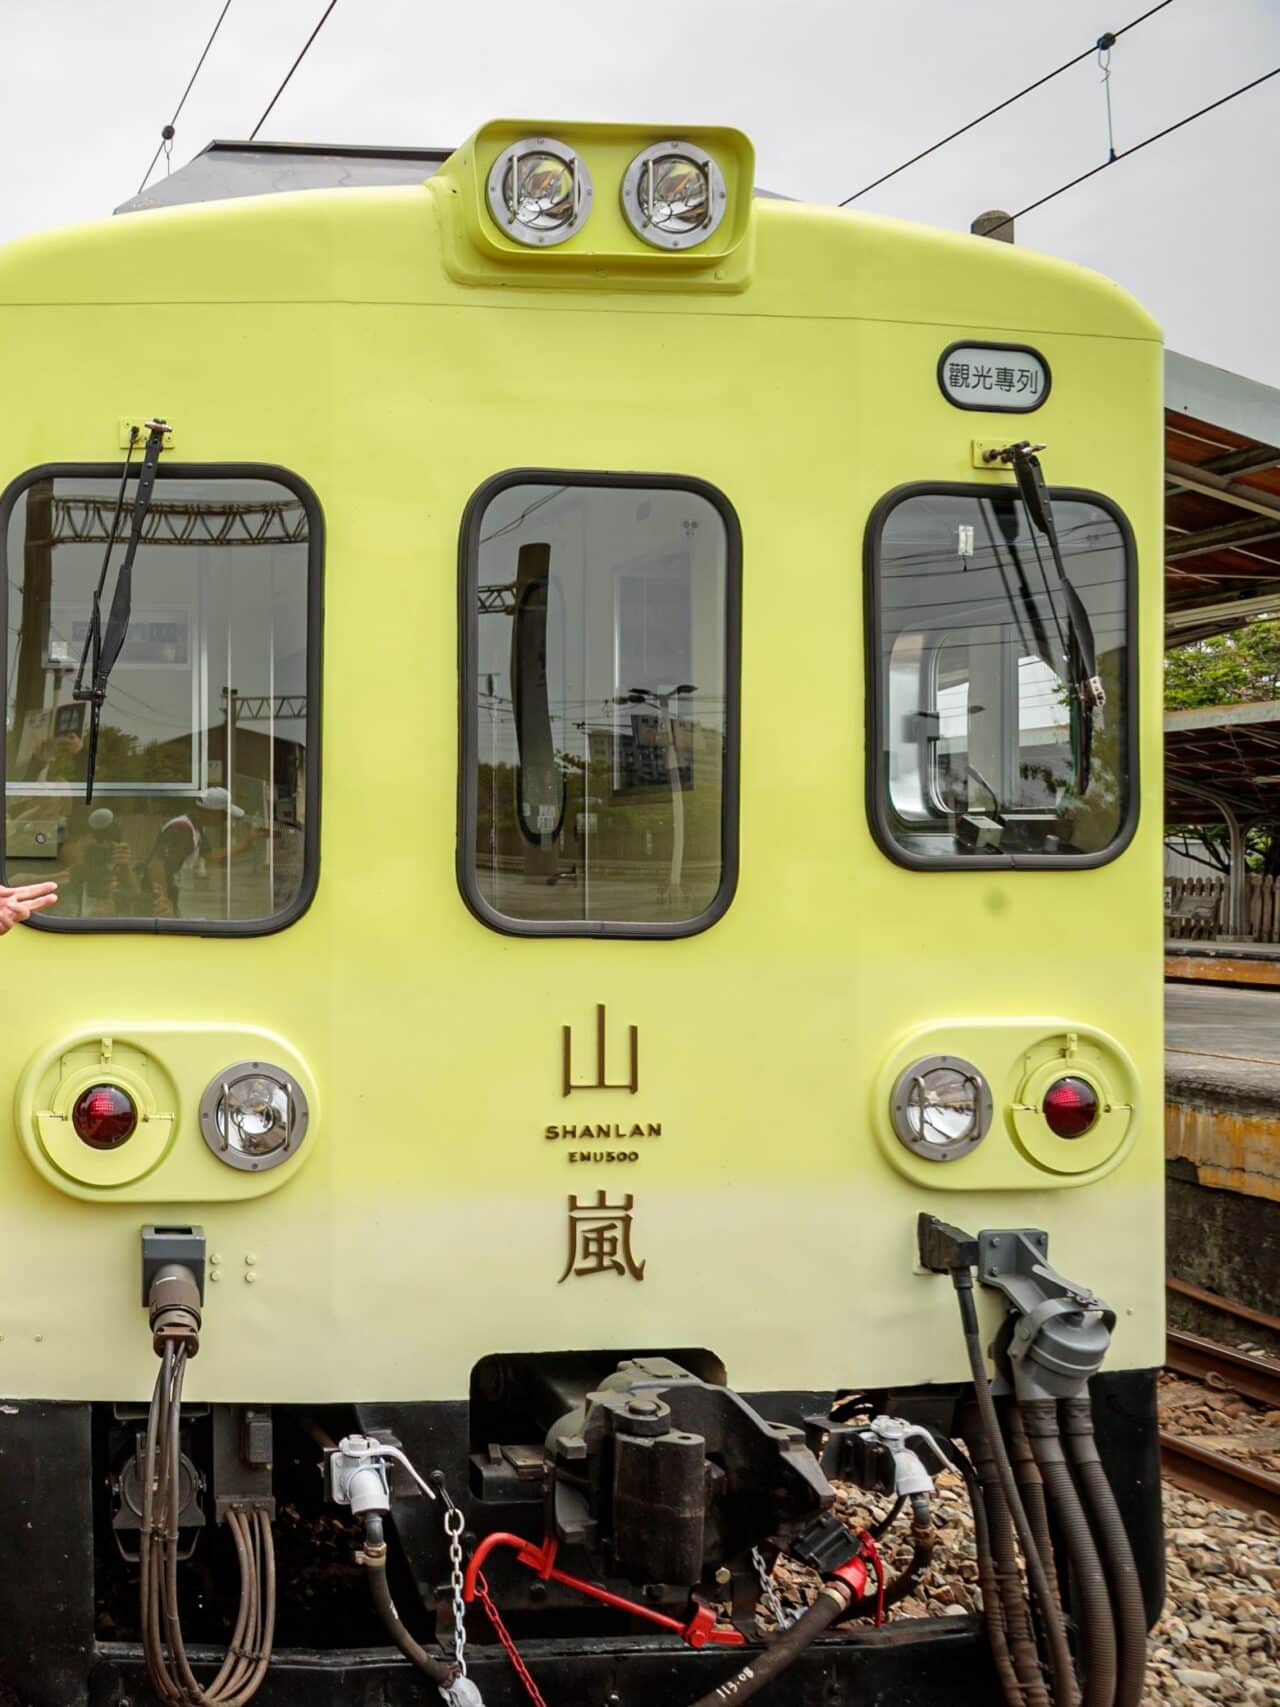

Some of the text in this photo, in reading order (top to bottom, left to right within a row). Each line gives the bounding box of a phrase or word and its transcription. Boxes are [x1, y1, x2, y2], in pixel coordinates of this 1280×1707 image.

[949, 362, 1038, 394] 觀光專列
[562, 1003, 638, 1098] 山
[545, 1123, 662, 1140] SHANLAN
[568, 1152, 639, 1163] EMU500
[557, 1189, 646, 1284] 嵐
